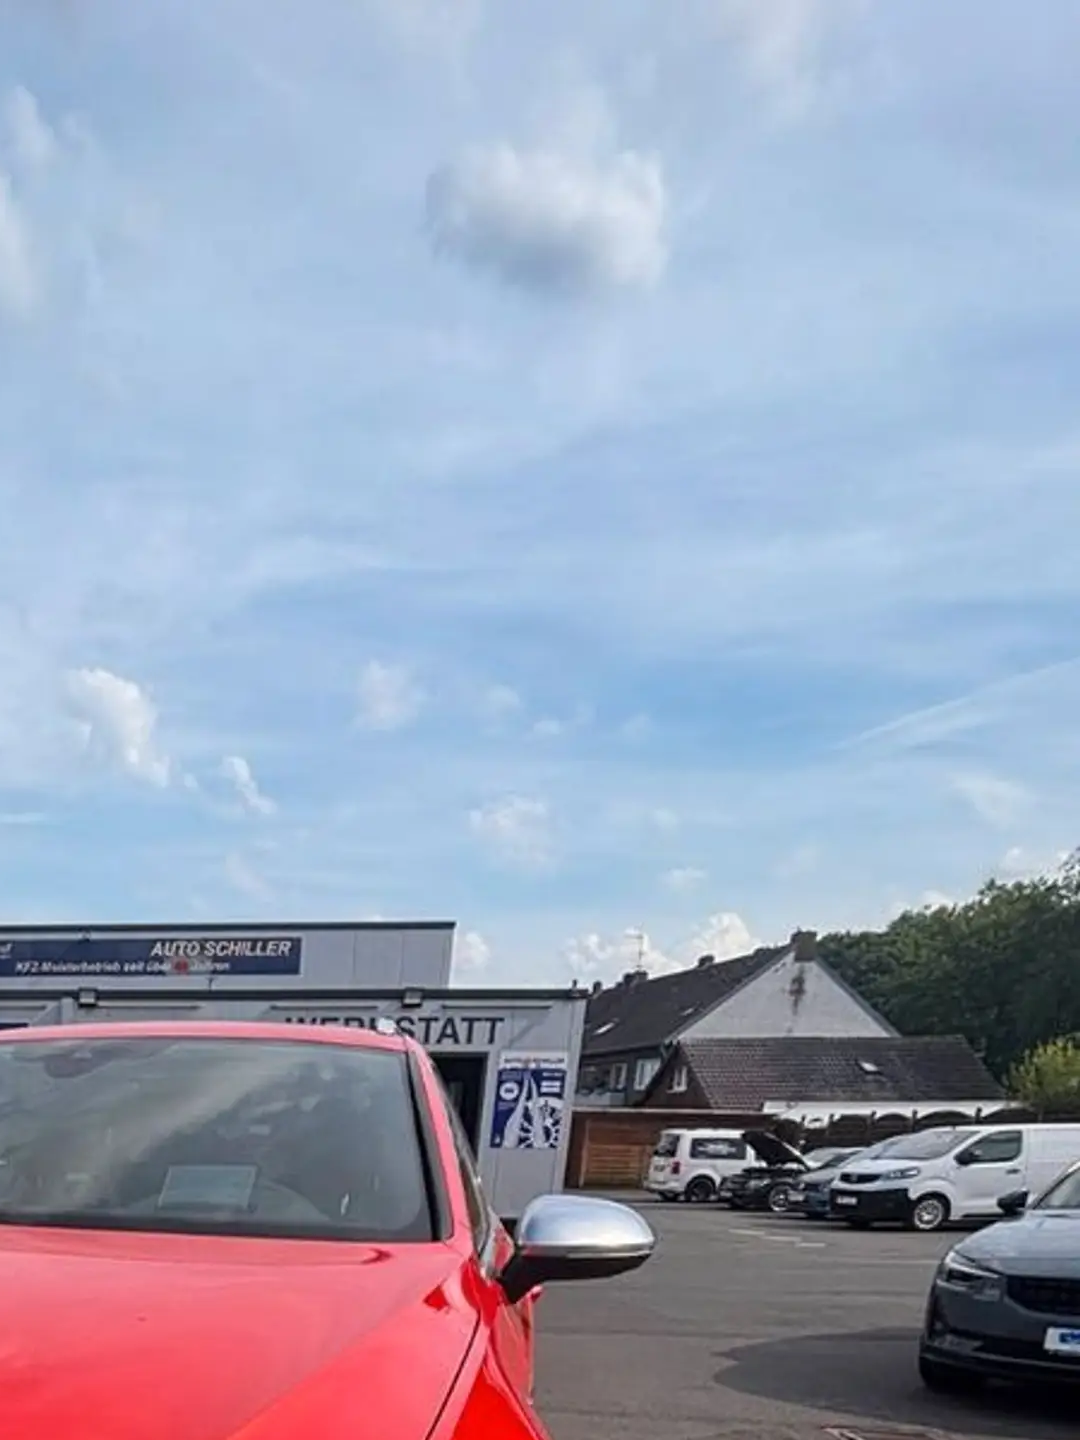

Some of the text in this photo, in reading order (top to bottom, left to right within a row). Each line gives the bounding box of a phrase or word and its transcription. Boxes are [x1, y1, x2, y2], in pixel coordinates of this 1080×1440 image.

[150, 941, 291, 956] AUTO SCHILLER
[285, 1016, 505, 1044] STATT
